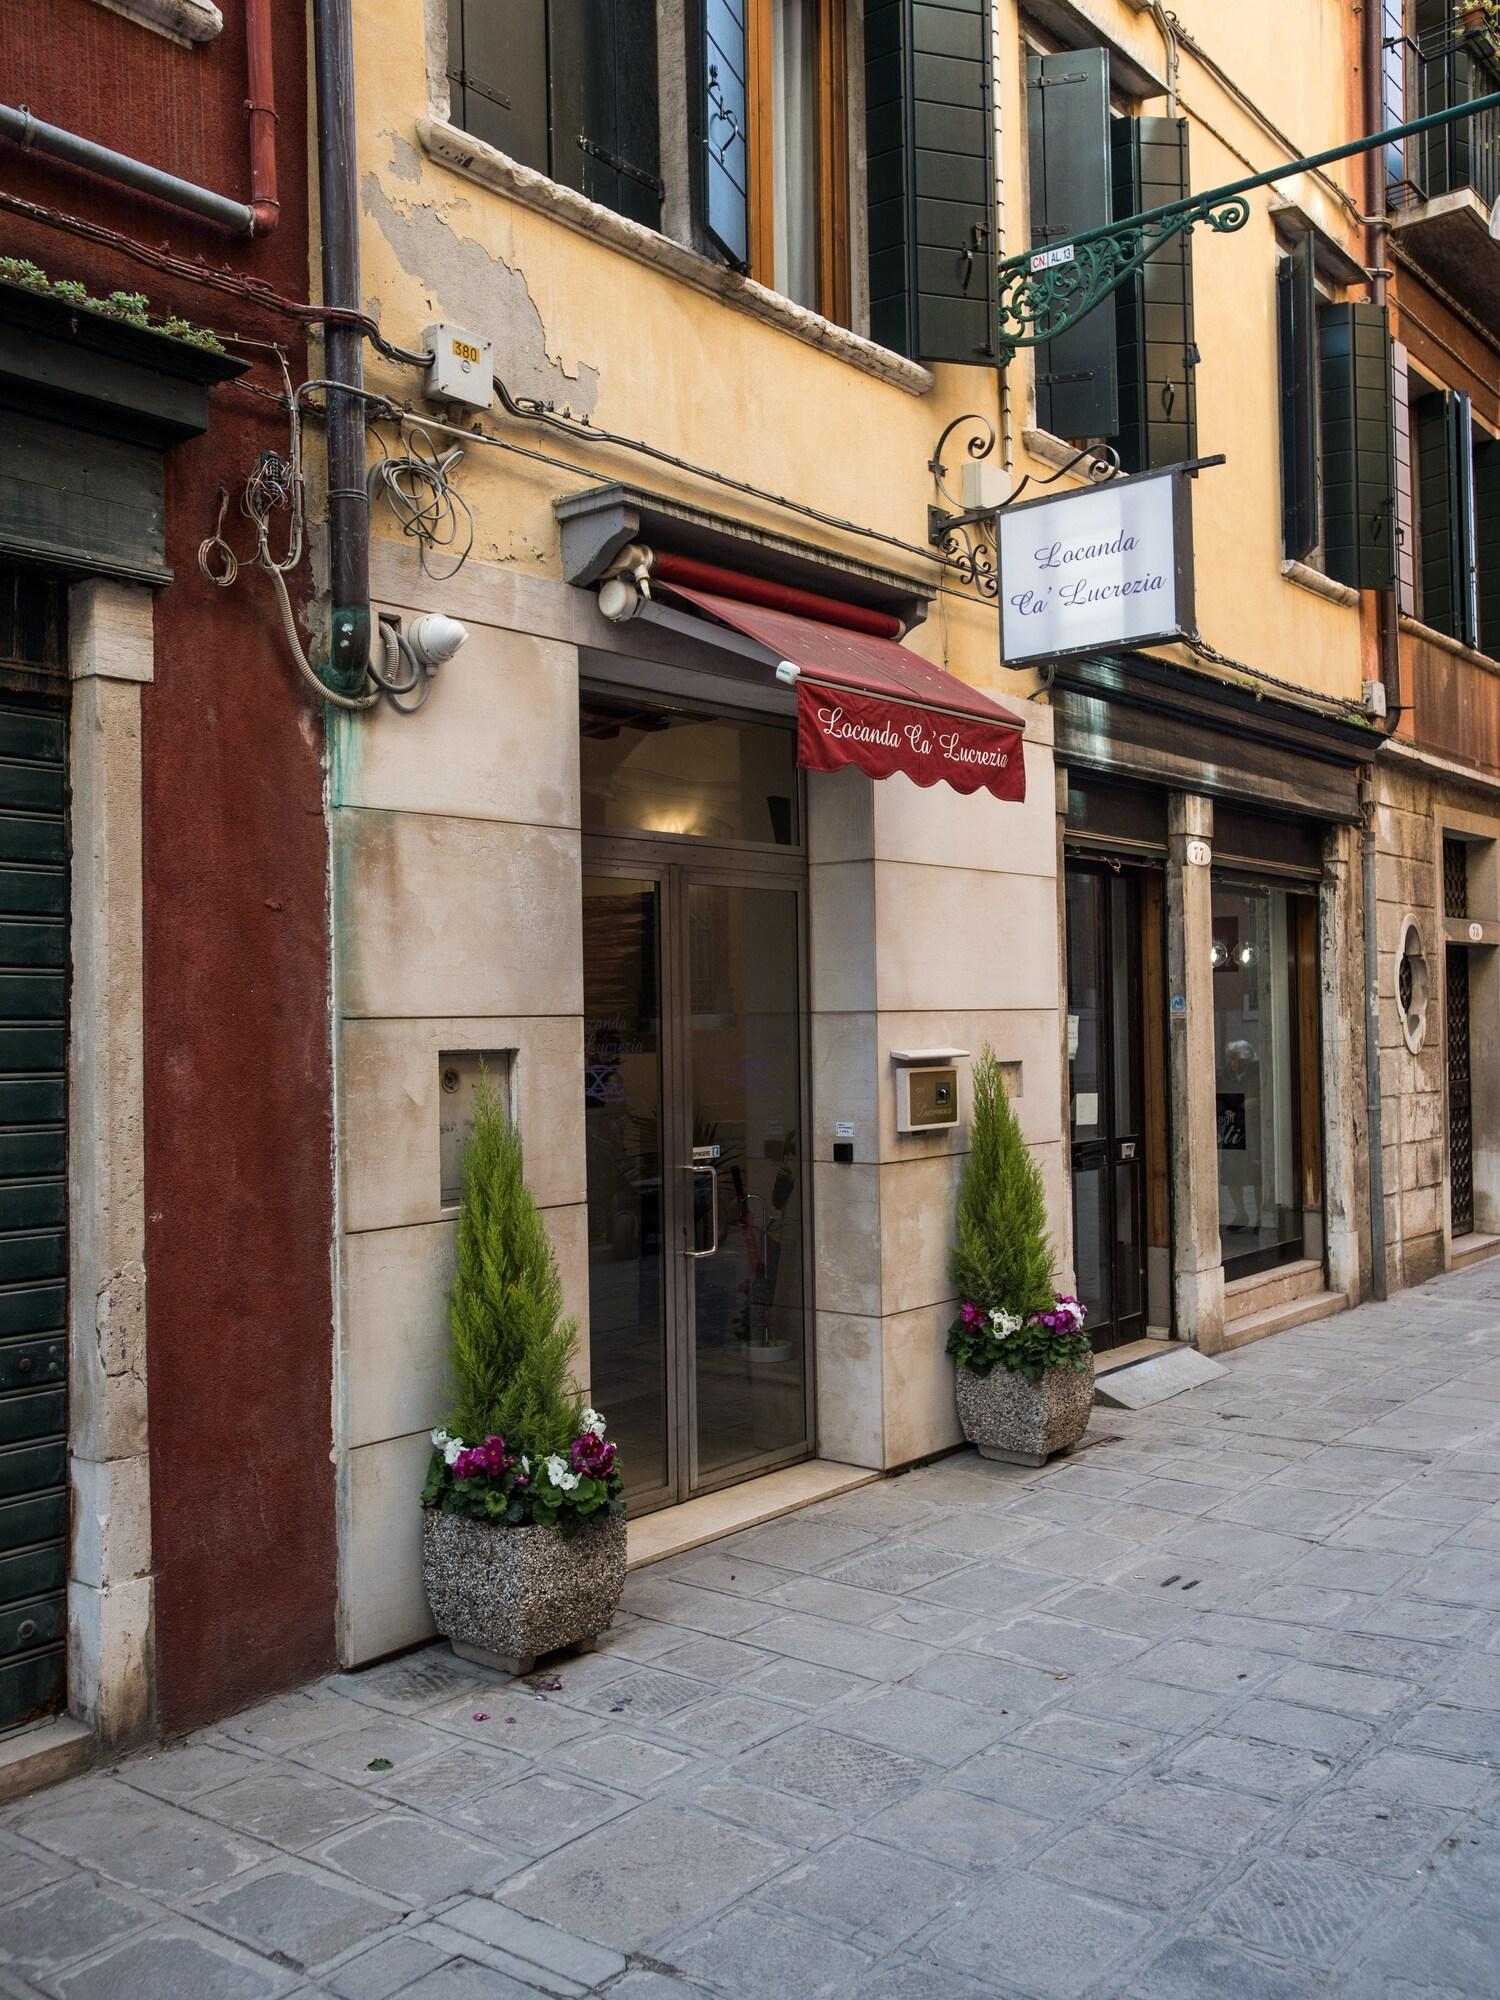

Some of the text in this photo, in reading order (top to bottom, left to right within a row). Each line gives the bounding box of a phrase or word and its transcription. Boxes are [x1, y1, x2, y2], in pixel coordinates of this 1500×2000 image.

[1032, 256, 1047, 268] CN.
[1063, 248, 1071, 260] 13
[455, 341, 477, 362] 380
[1034, 529, 1140, 569] Locanda
[1059, 573, 1167, 606] Lucrezia
[817, 706, 902, 748] Locanda
[939, 732, 1008, 768] Lucrezia
[1194, 846, 1203, 861] 77
